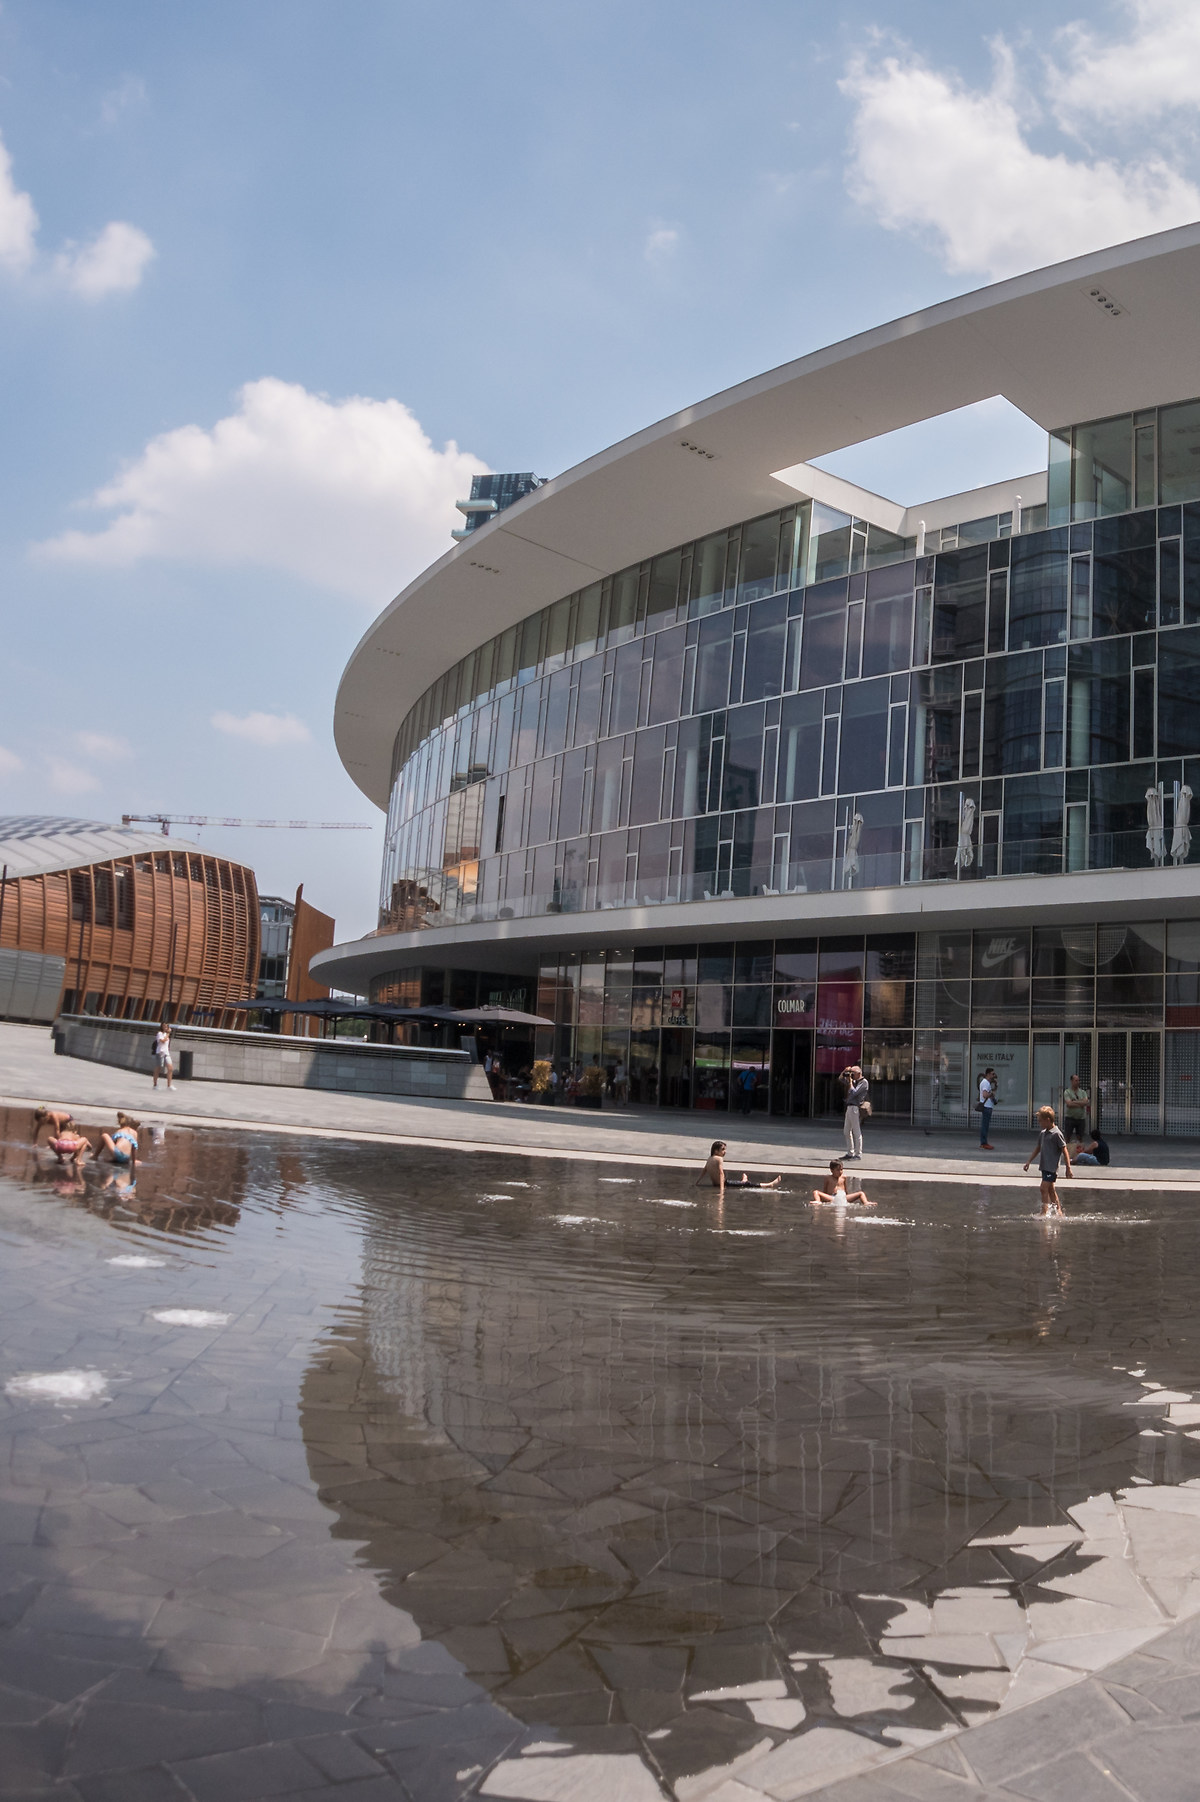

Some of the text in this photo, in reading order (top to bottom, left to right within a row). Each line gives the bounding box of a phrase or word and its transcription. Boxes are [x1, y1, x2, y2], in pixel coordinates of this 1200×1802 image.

[987, 937, 1017, 953] NIKE
[777, 999, 805, 1013] COLMAR
[976, 1053, 1015, 1061] NIKE ITALY
